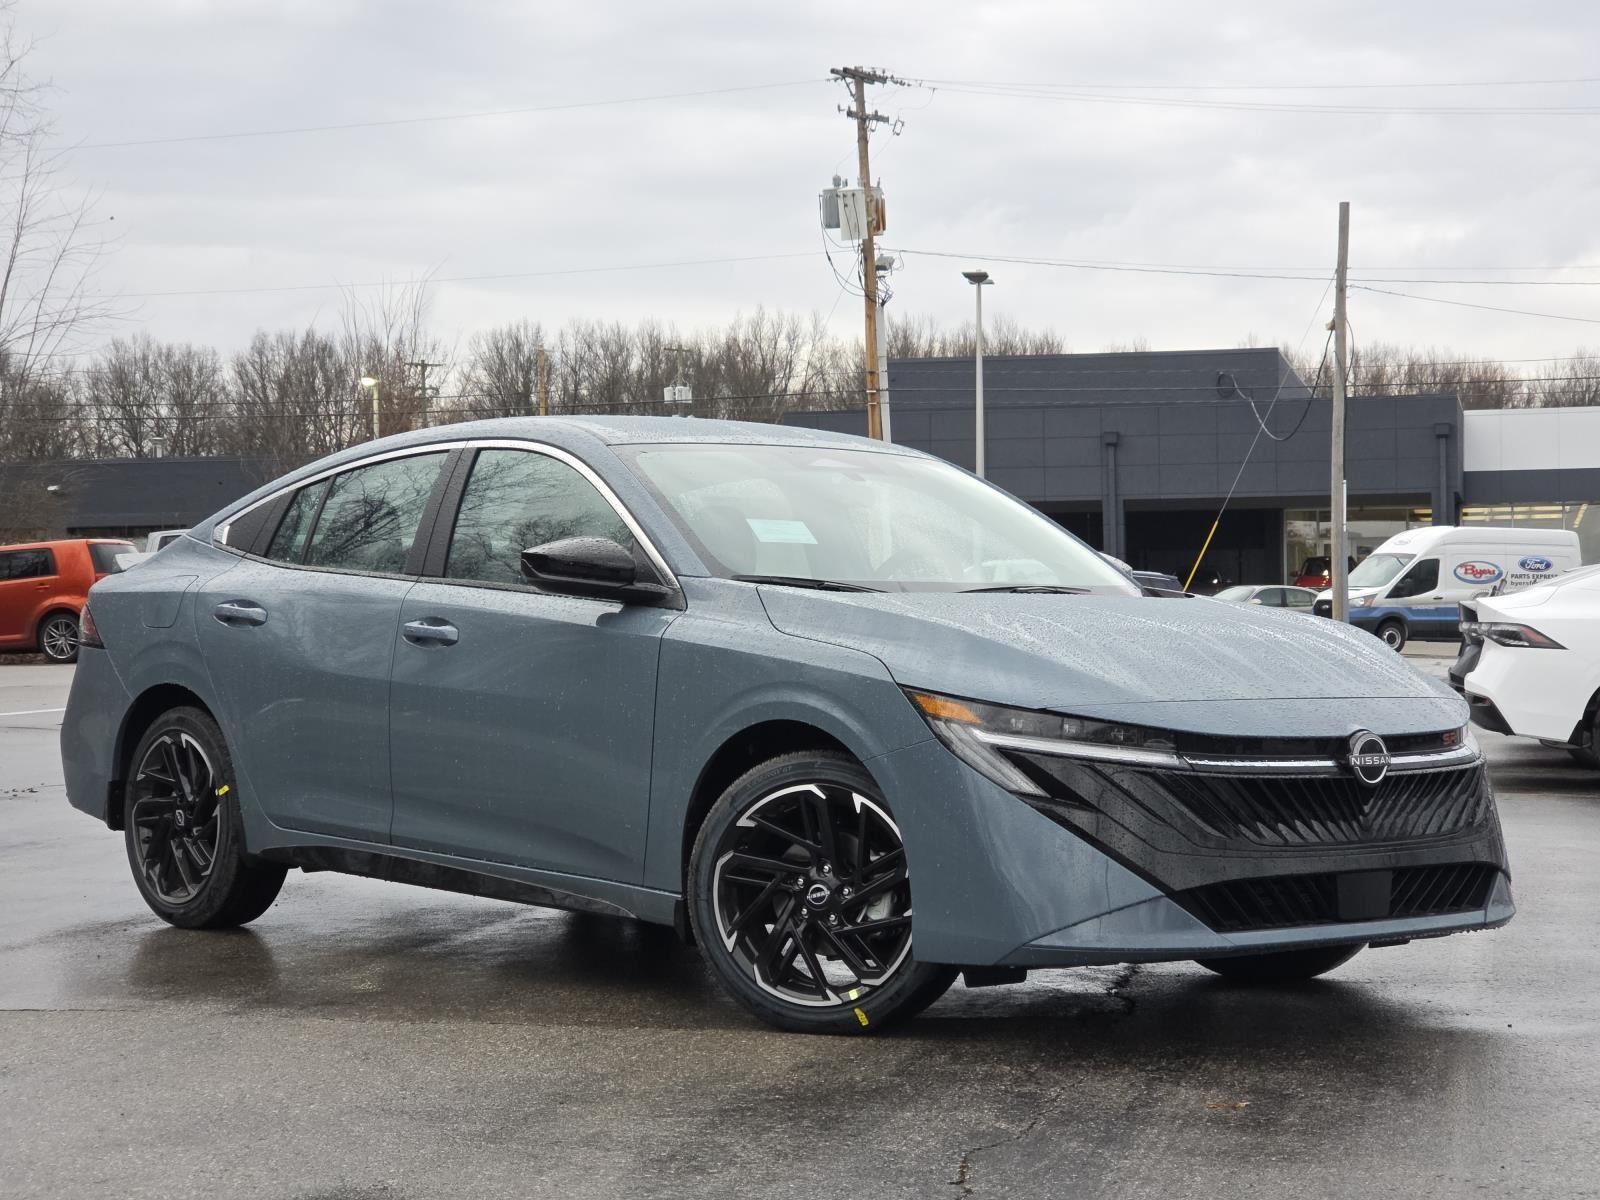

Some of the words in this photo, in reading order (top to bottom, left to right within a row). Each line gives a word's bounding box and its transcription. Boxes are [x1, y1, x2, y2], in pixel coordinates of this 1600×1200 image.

[1525, 558, 1546, 569] Ford
[1459, 564, 1496, 579] Byers
[1351, 755, 1391, 766] NISSAN
